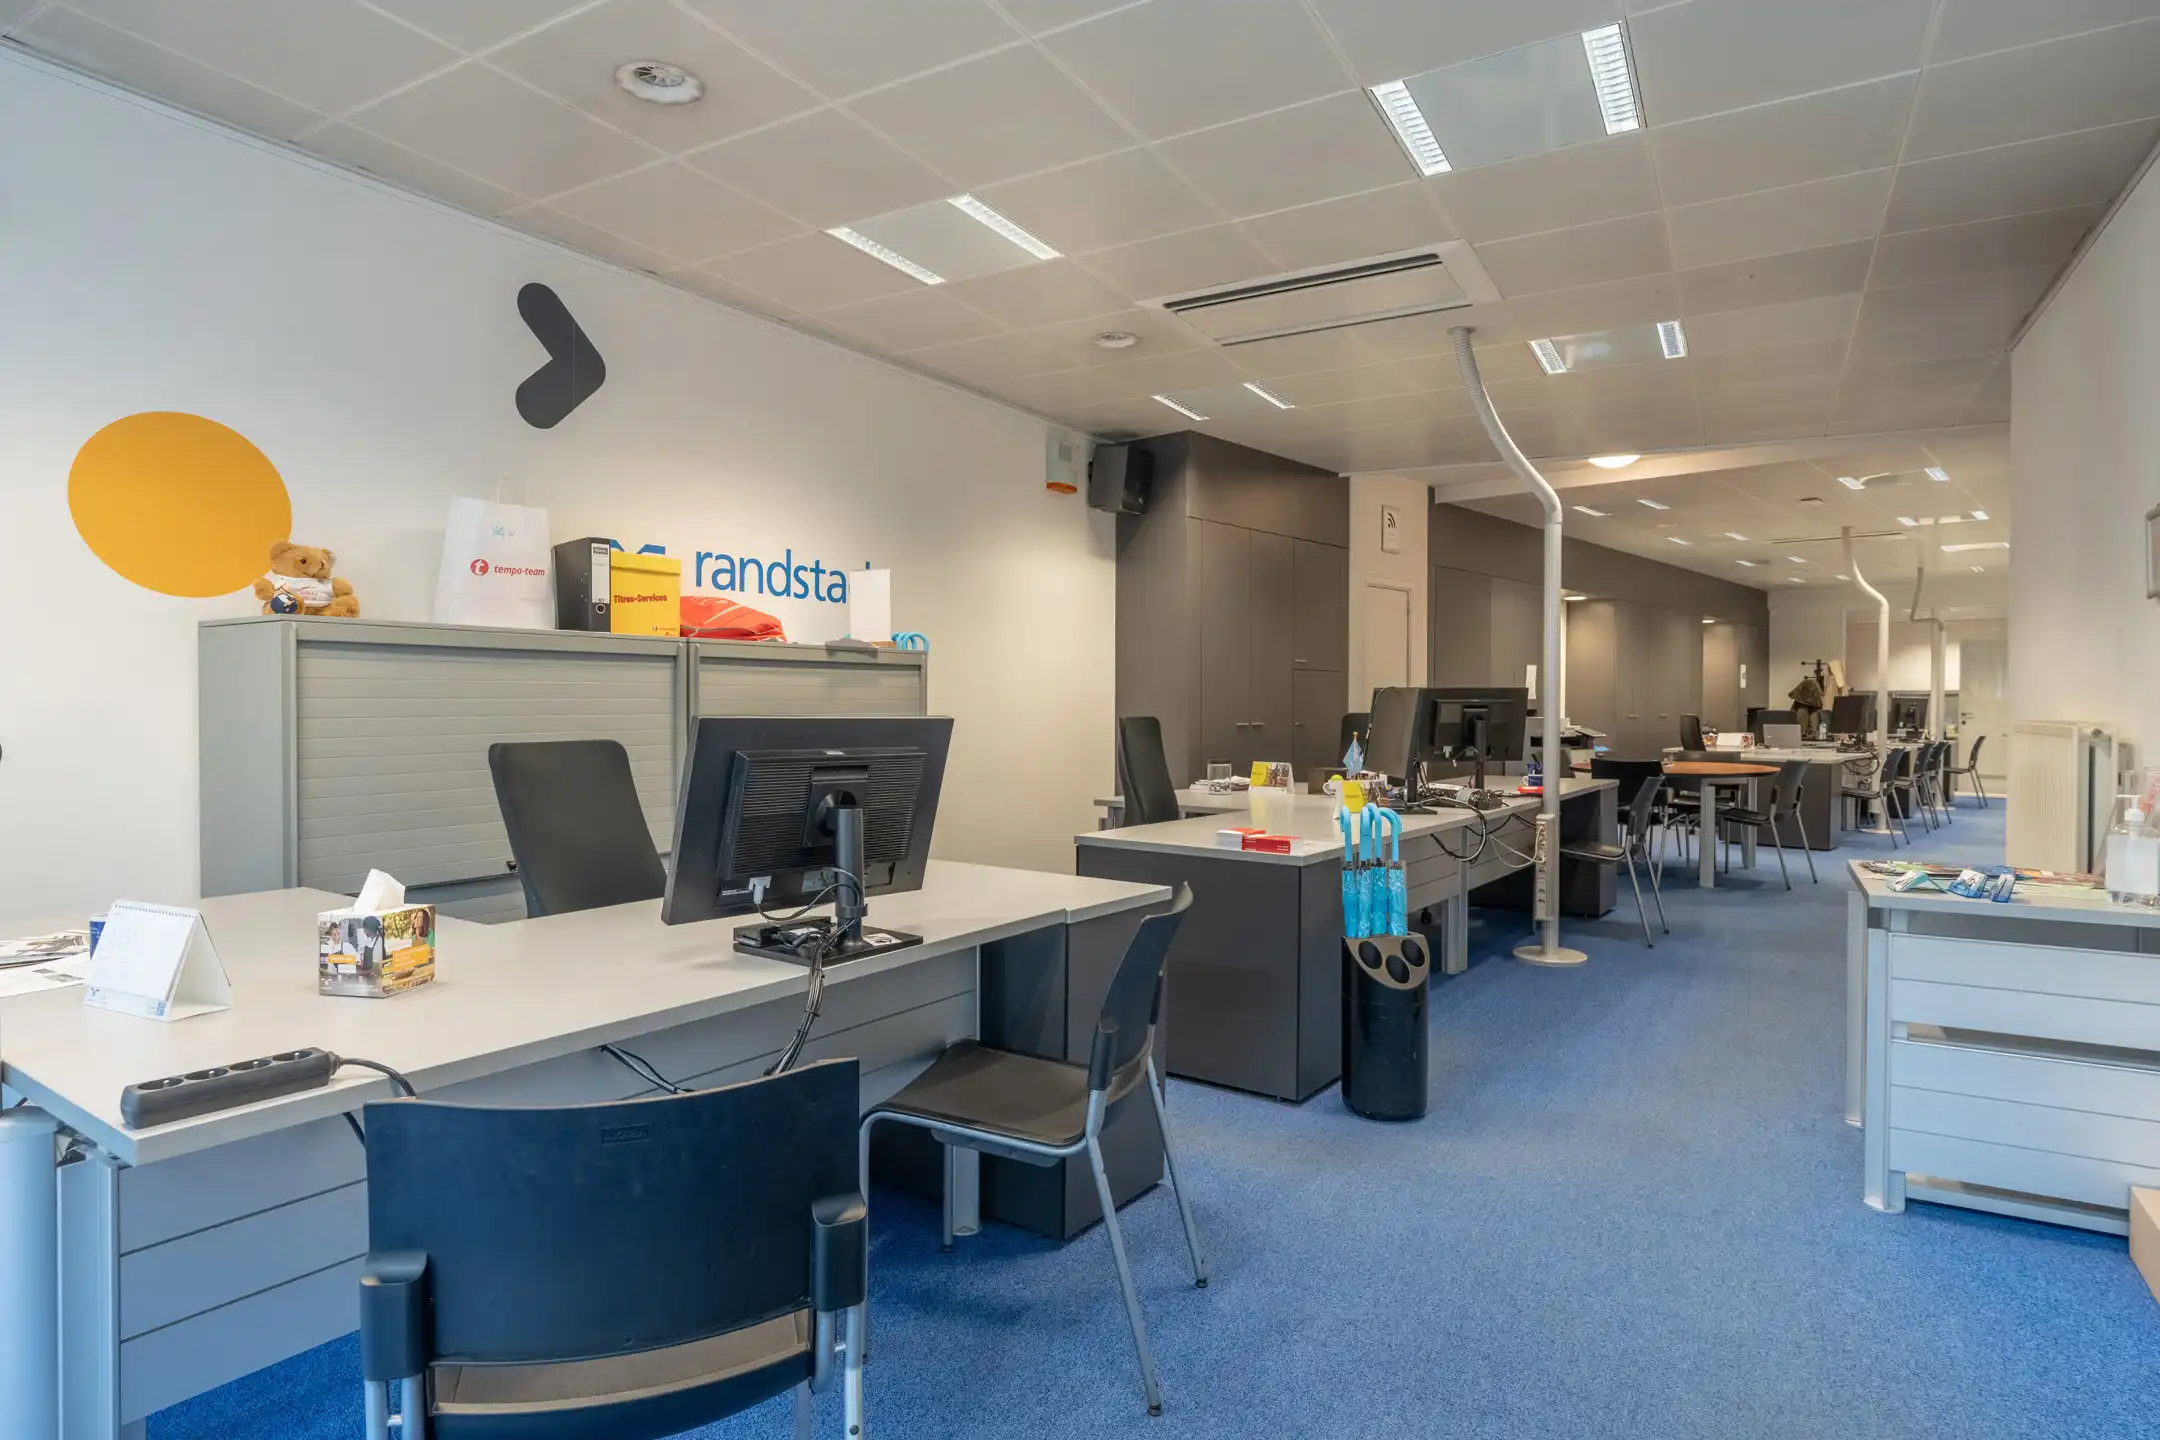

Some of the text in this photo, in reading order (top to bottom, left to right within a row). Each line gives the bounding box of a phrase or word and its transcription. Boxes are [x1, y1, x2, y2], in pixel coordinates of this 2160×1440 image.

[494, 565, 546, 577] tempo-team
[695, 548, 870, 604] randsta
[613, 593, 668, 605] Titres-Services
